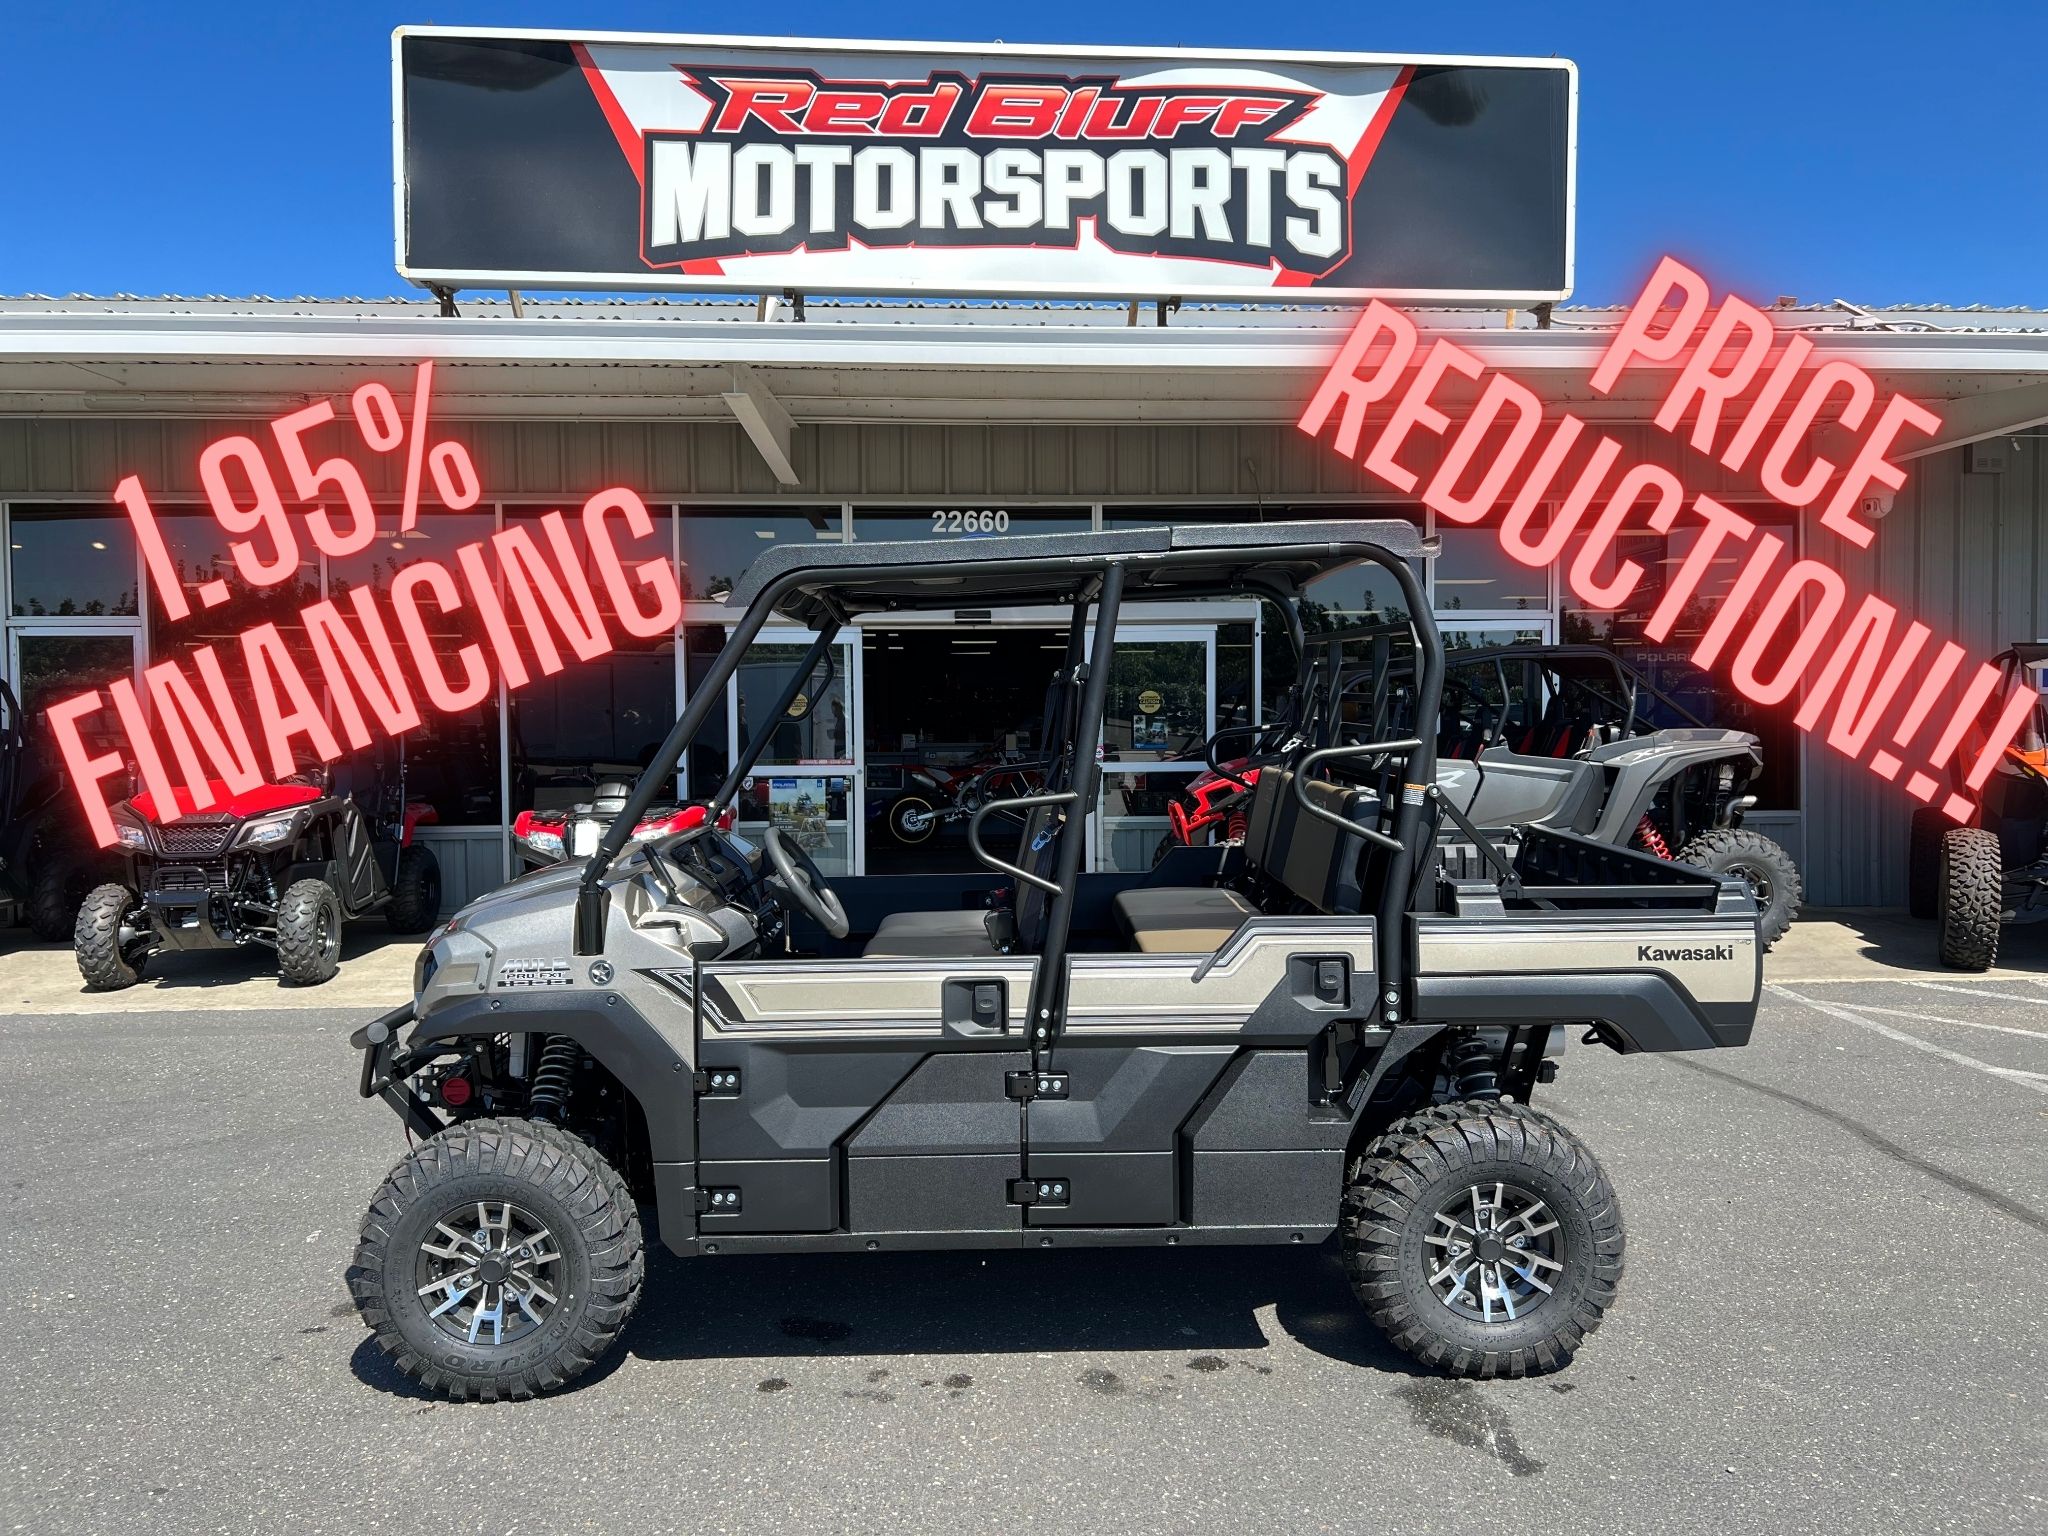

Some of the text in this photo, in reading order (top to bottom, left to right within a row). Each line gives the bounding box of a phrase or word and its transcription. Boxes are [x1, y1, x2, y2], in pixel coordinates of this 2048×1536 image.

[711, 76, 963, 137] Red
[651, 141, 1342, 259] MOTORSPORTS
[932, 510, 1009, 532] 22660
[1637, 944, 1734, 962] Kawasaki
[500, 957, 571, 973] MULE
